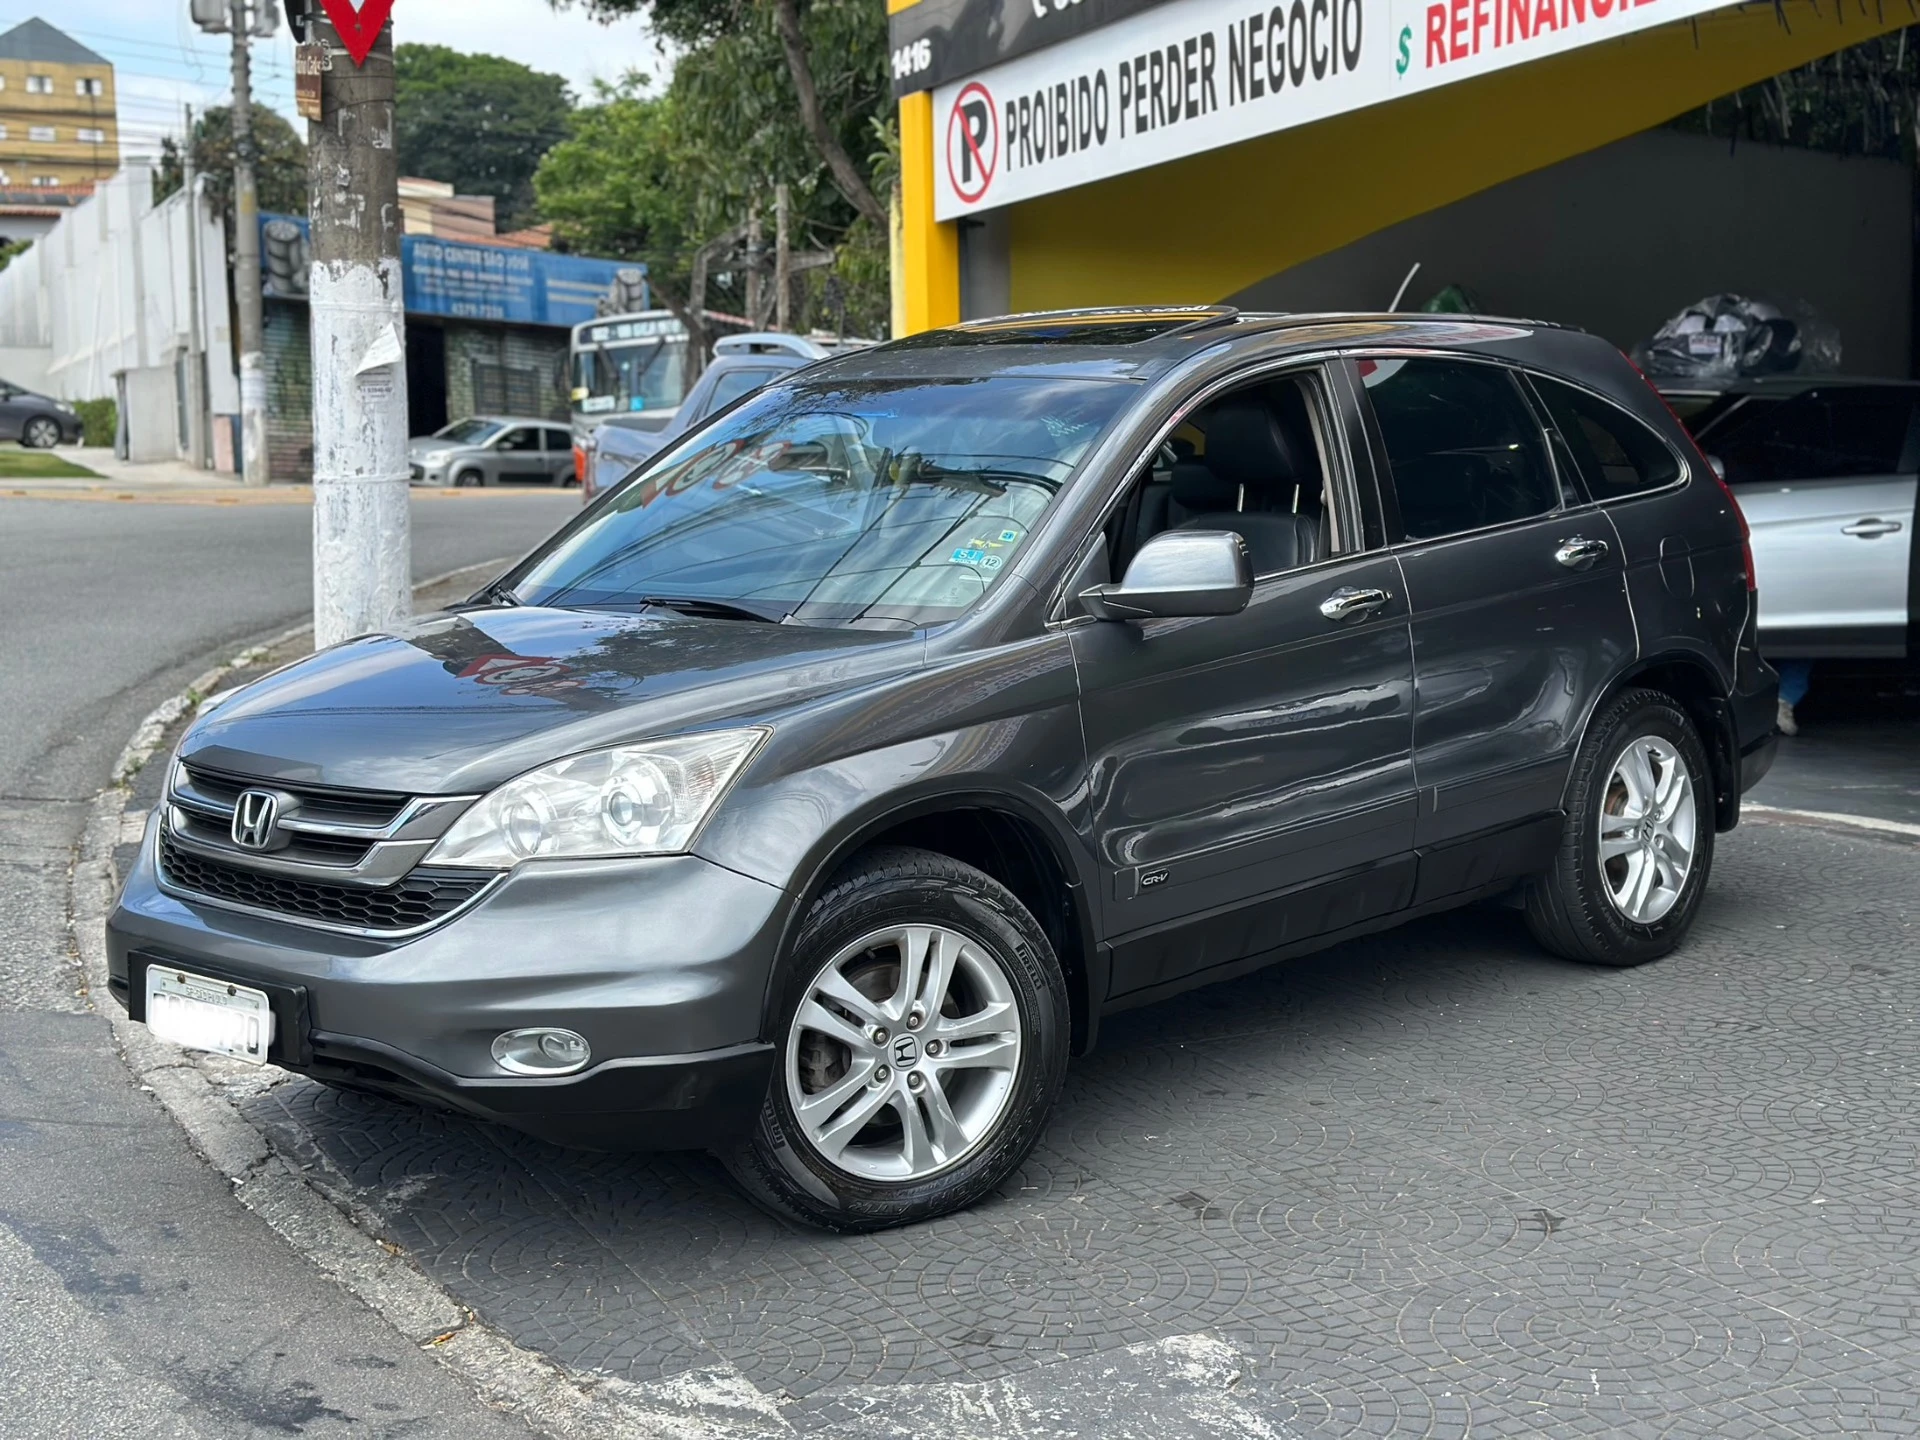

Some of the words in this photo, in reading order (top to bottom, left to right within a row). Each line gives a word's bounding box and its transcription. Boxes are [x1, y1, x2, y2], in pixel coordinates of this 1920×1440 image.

[891, 38, 932, 80] 1416
[1006, 68, 1108, 172] PROIBIDO
[1119, 31, 1218, 139] PERDER
[1229, 0, 1363, 106] NEGOCIO
[444, 247, 482, 265] CENTER
[985, 558, 998, 568] 12
[1142, 872, 1168, 886] CR-V
[1015, 941, 1046, 991] PIRELLI
